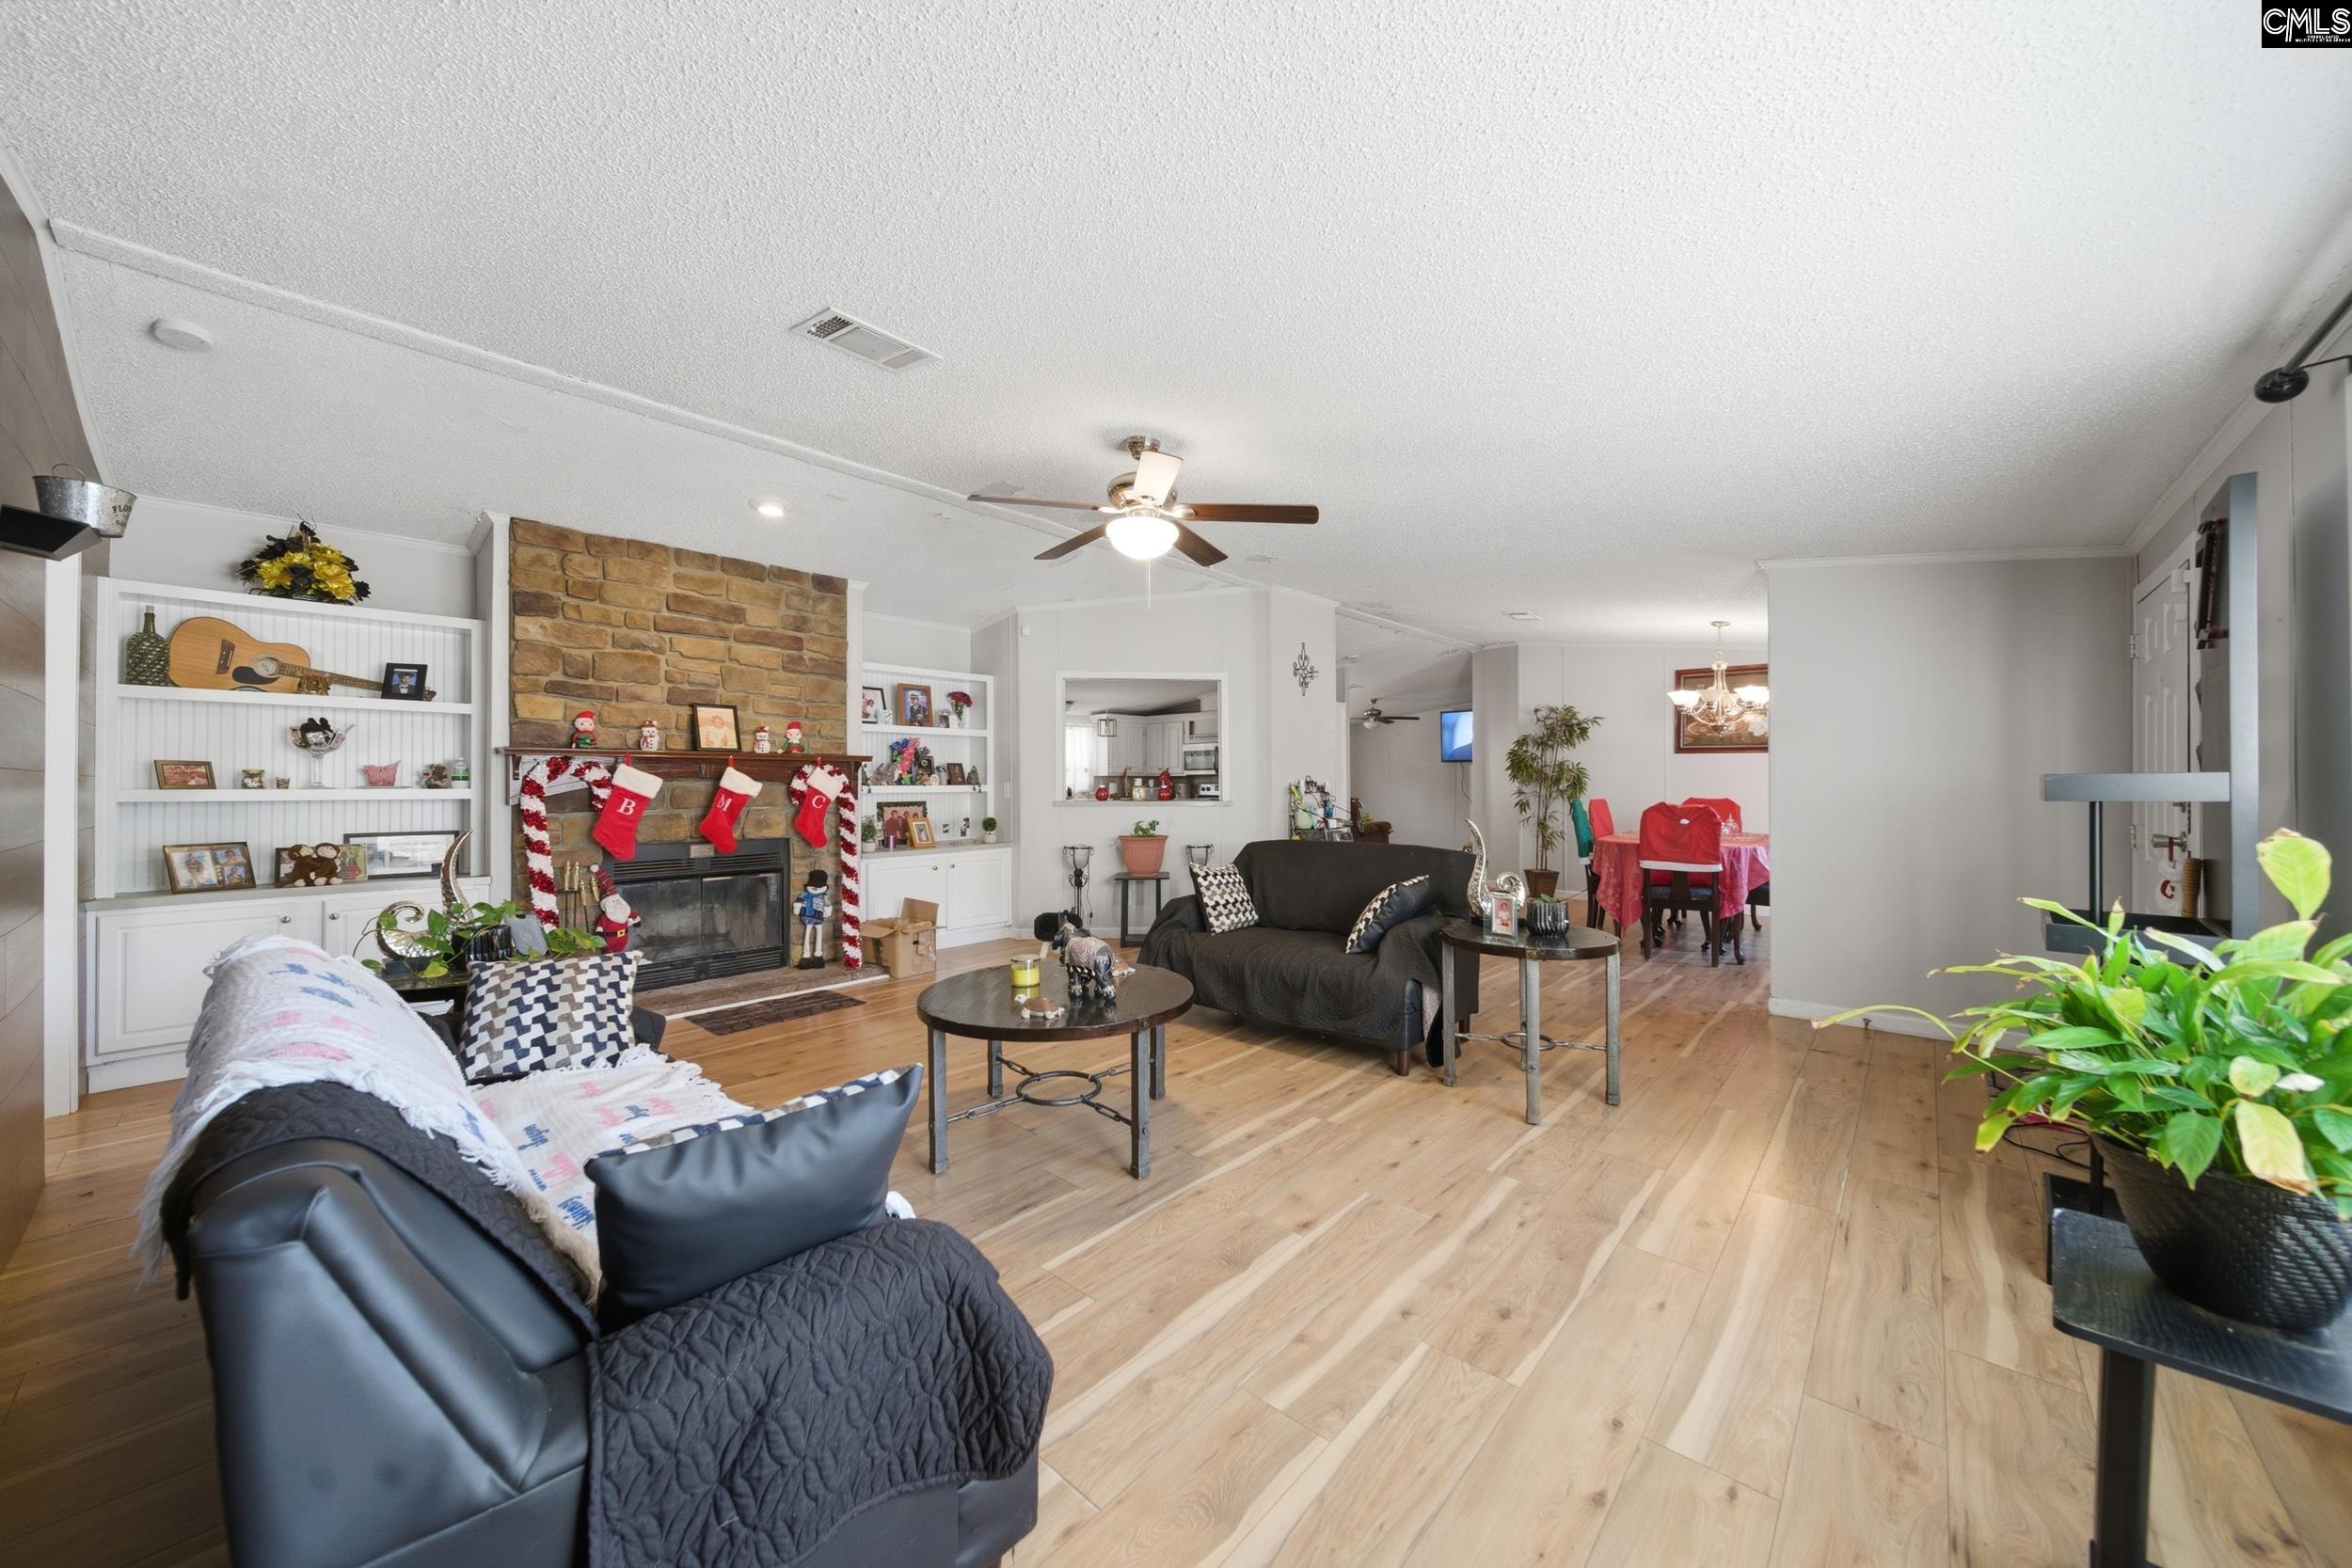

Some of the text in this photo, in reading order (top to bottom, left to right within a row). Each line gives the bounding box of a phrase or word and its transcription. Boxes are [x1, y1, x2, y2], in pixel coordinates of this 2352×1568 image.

[616, 798, 636, 816] B
[716, 794, 732, 812] M
[812, 795, 826, 809] C
